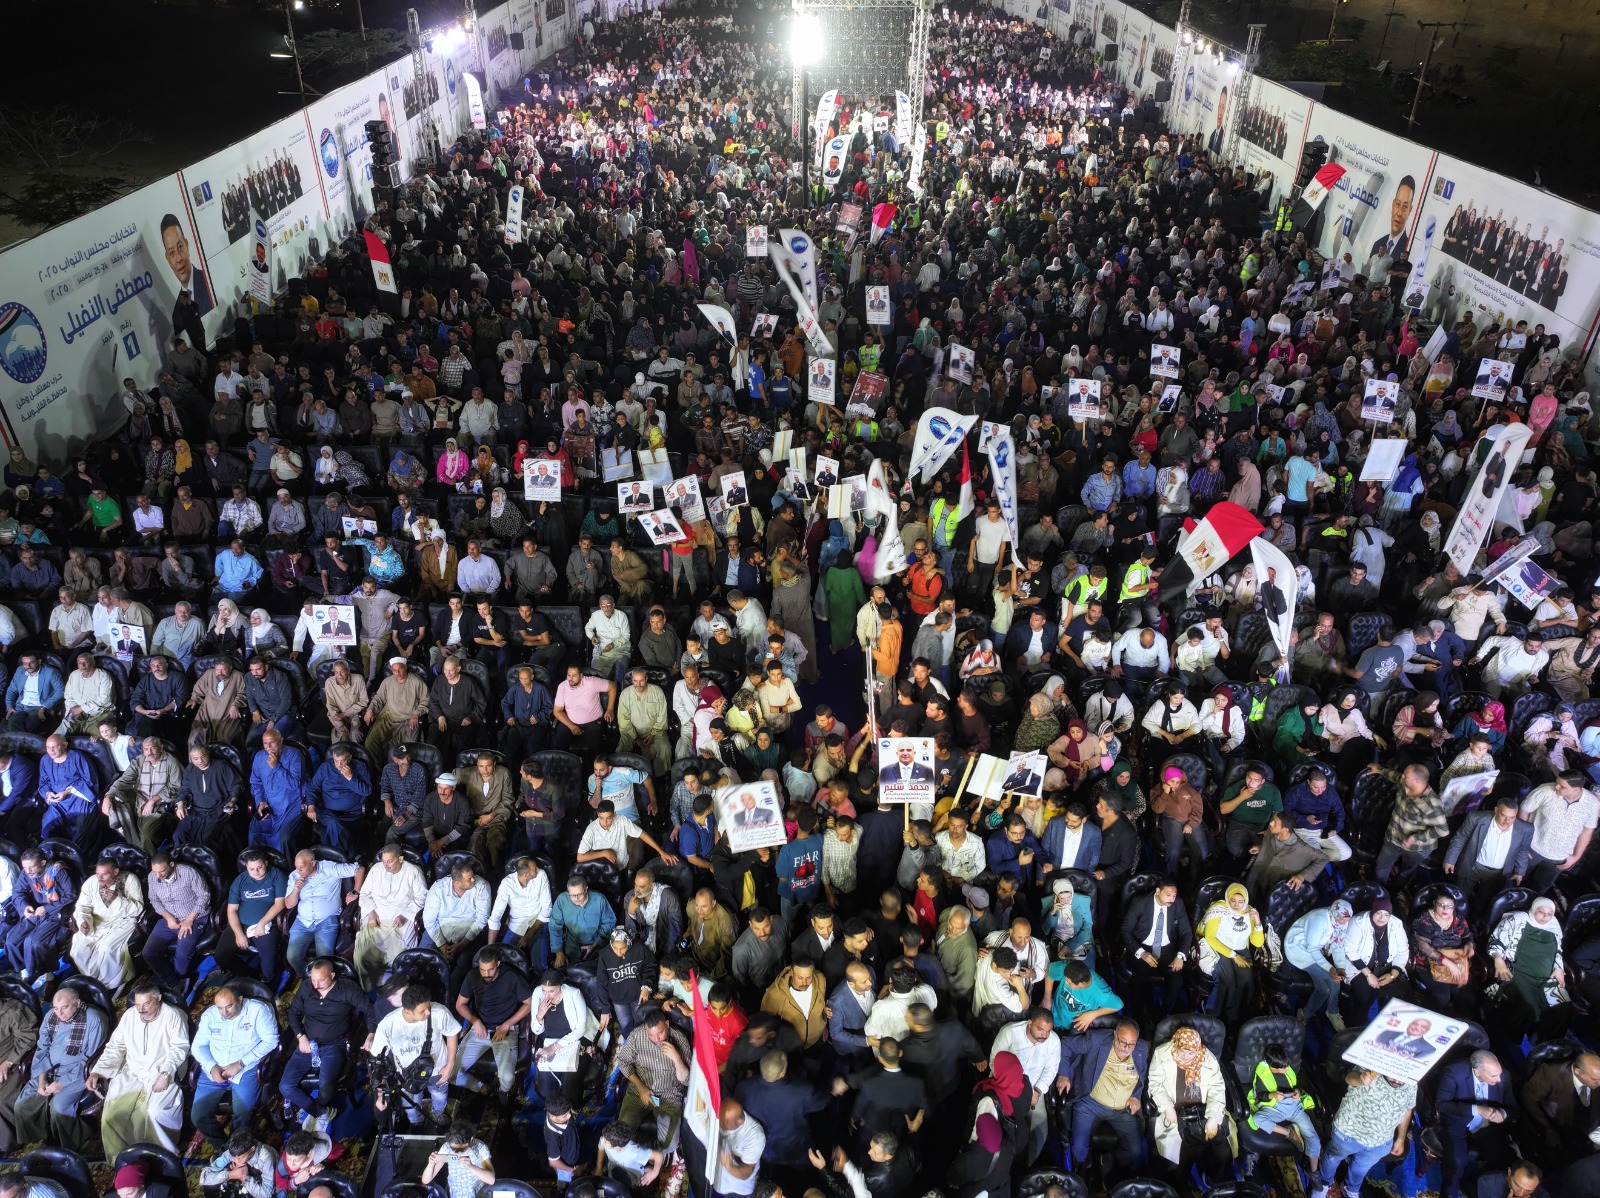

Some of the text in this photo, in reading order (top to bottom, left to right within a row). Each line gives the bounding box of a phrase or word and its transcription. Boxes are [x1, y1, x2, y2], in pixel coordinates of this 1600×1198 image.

[1349, 184, 1379, 210] مصطفى
[38, 222, 138, 283] انتخابات مجلس النواب ٢٠٢٥
[106, 270, 153, 316] مصطفى
[120, 320, 132, 333] رقم
[16, 373, 62, 410] حزب مستقبل وطن
[46, 386, 68, 404] محافظة
[884, 783, 904, 794] سليم
[794, 850, 819, 868] FEAR
